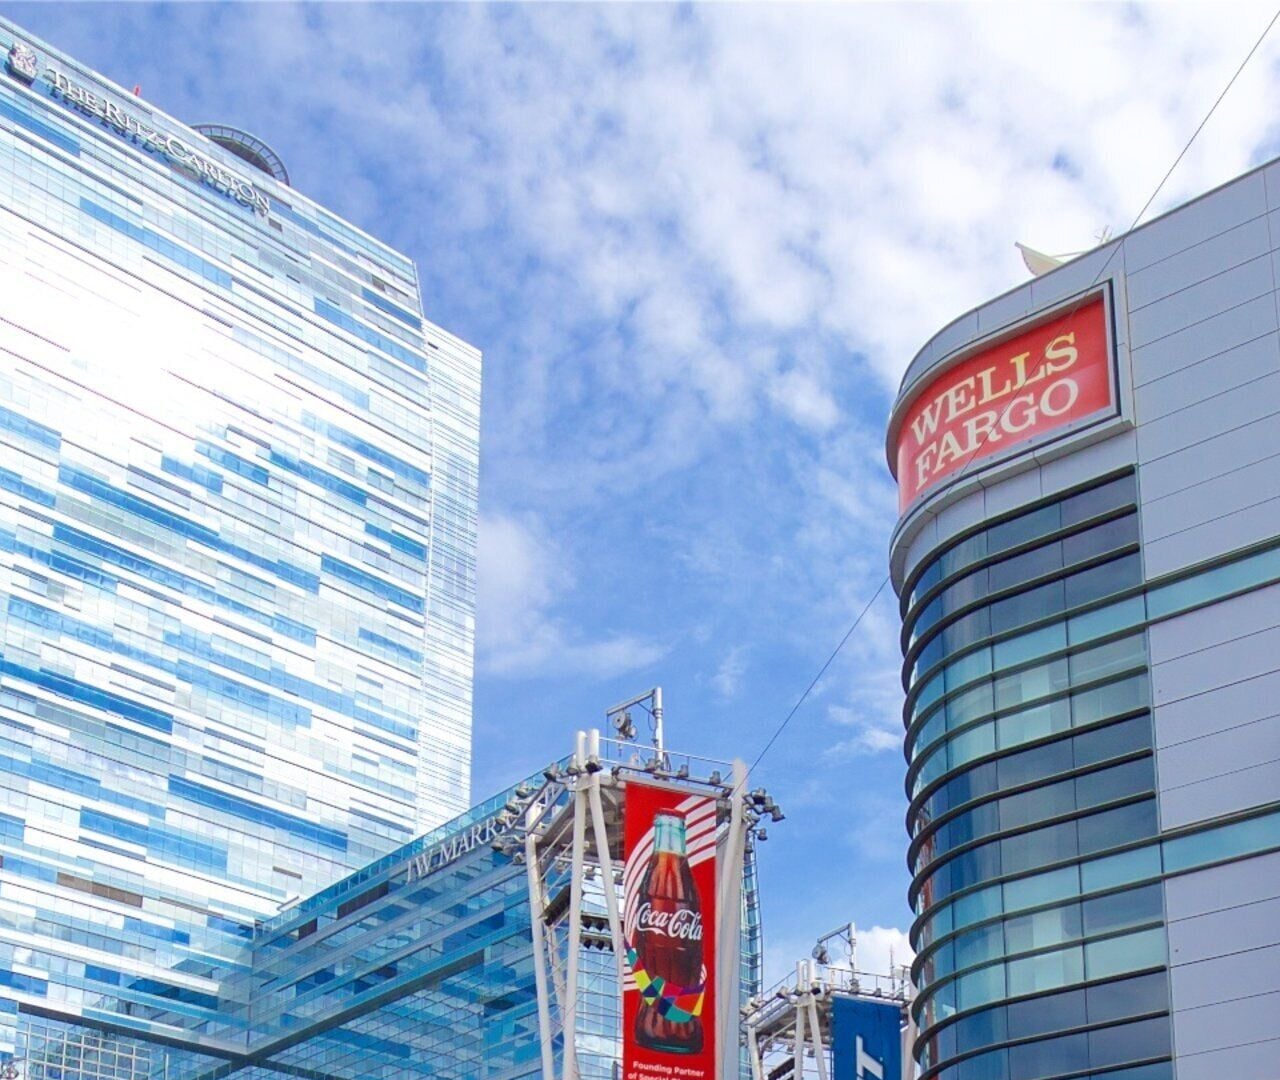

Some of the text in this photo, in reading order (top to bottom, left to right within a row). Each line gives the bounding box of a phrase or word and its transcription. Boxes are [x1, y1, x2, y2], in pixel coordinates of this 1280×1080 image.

[46, 68, 270, 216] THE RITZ-CARLTON
[910, 332, 1079, 446] WELLS
[914, 378, 1080, 491] FARGO
[635, 902, 704, 940] Coca-Cola
[628, 1072, 637, 1080] of
[633, 1061, 704, 1077] Founding Partner
